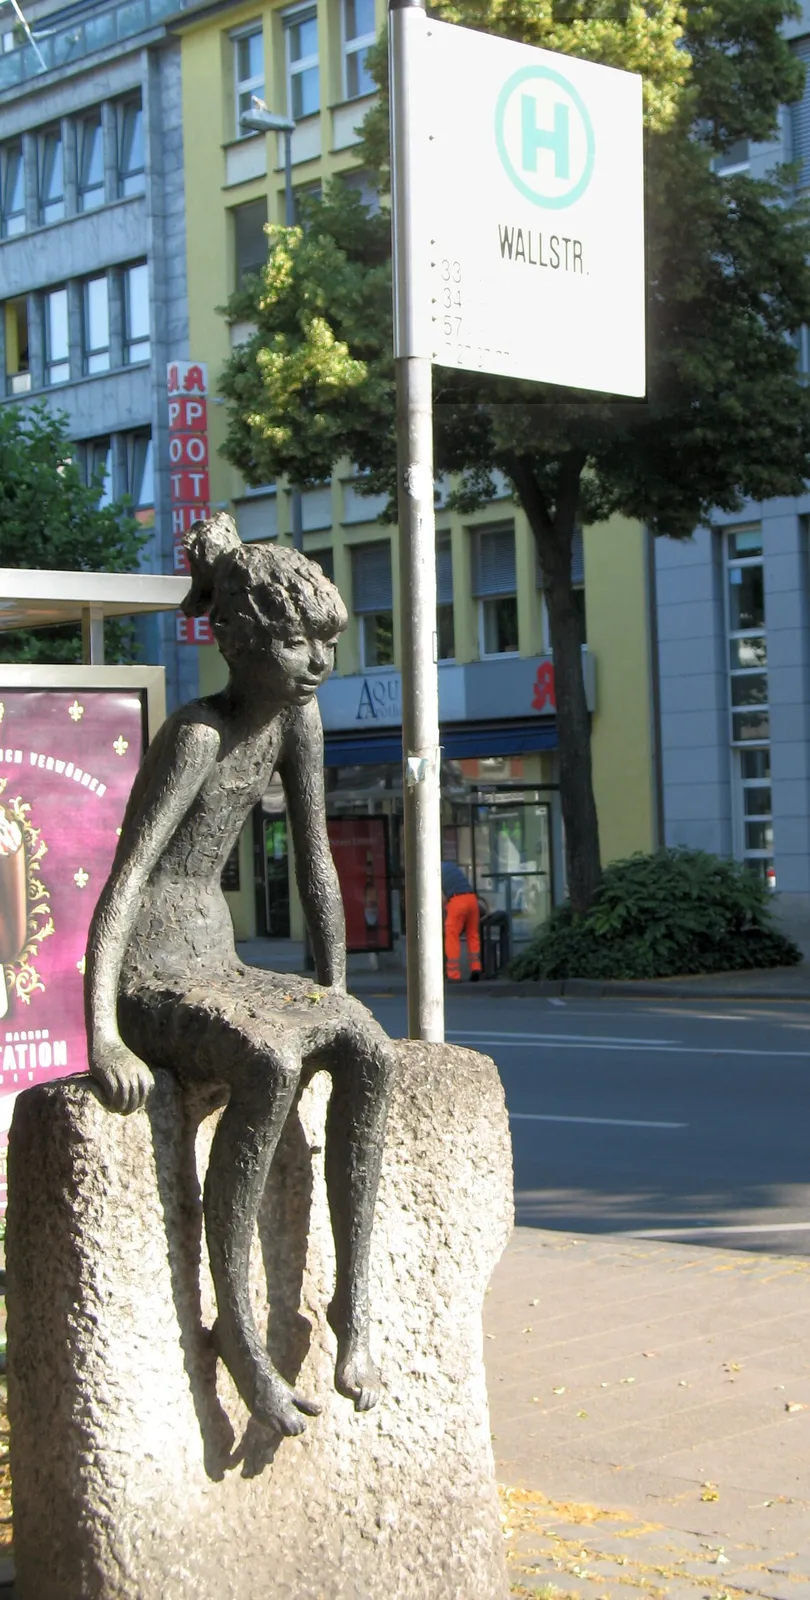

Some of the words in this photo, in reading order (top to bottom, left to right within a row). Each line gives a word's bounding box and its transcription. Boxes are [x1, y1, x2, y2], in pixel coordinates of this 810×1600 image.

[521, 92, 569, 180] H
[441, 259, 461, 283] 33
[498, 223, 589, 276] WALLSTR.
[444, 314, 462, 337] 57
[168, 365, 188, 641] APOTHEE
[355, 678, 399, 719] AQU
